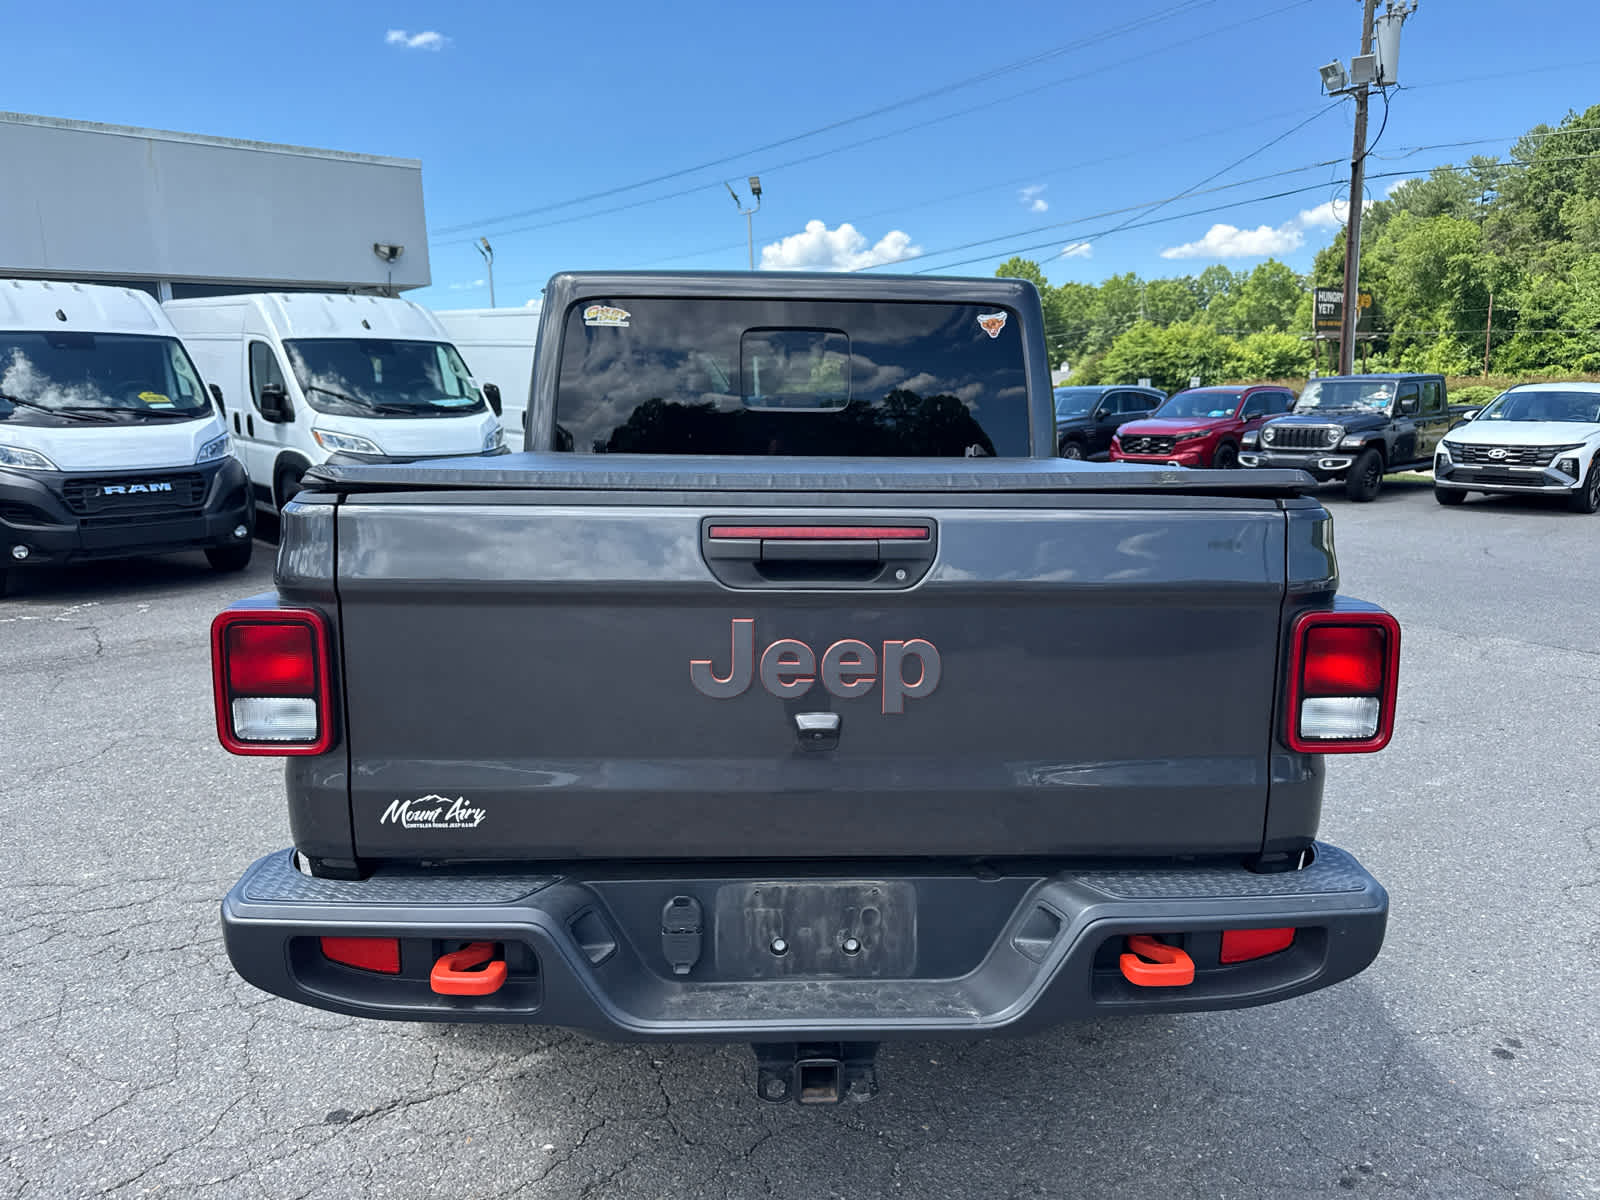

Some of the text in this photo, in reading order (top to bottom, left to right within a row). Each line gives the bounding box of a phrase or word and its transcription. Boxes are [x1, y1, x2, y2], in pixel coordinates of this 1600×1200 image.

[1318, 304, 1334, 314] YET?
[103, 482, 172, 495] RAM
[689, 618, 941, 715] Jeep
[380, 796, 486, 829] Mount Airy
